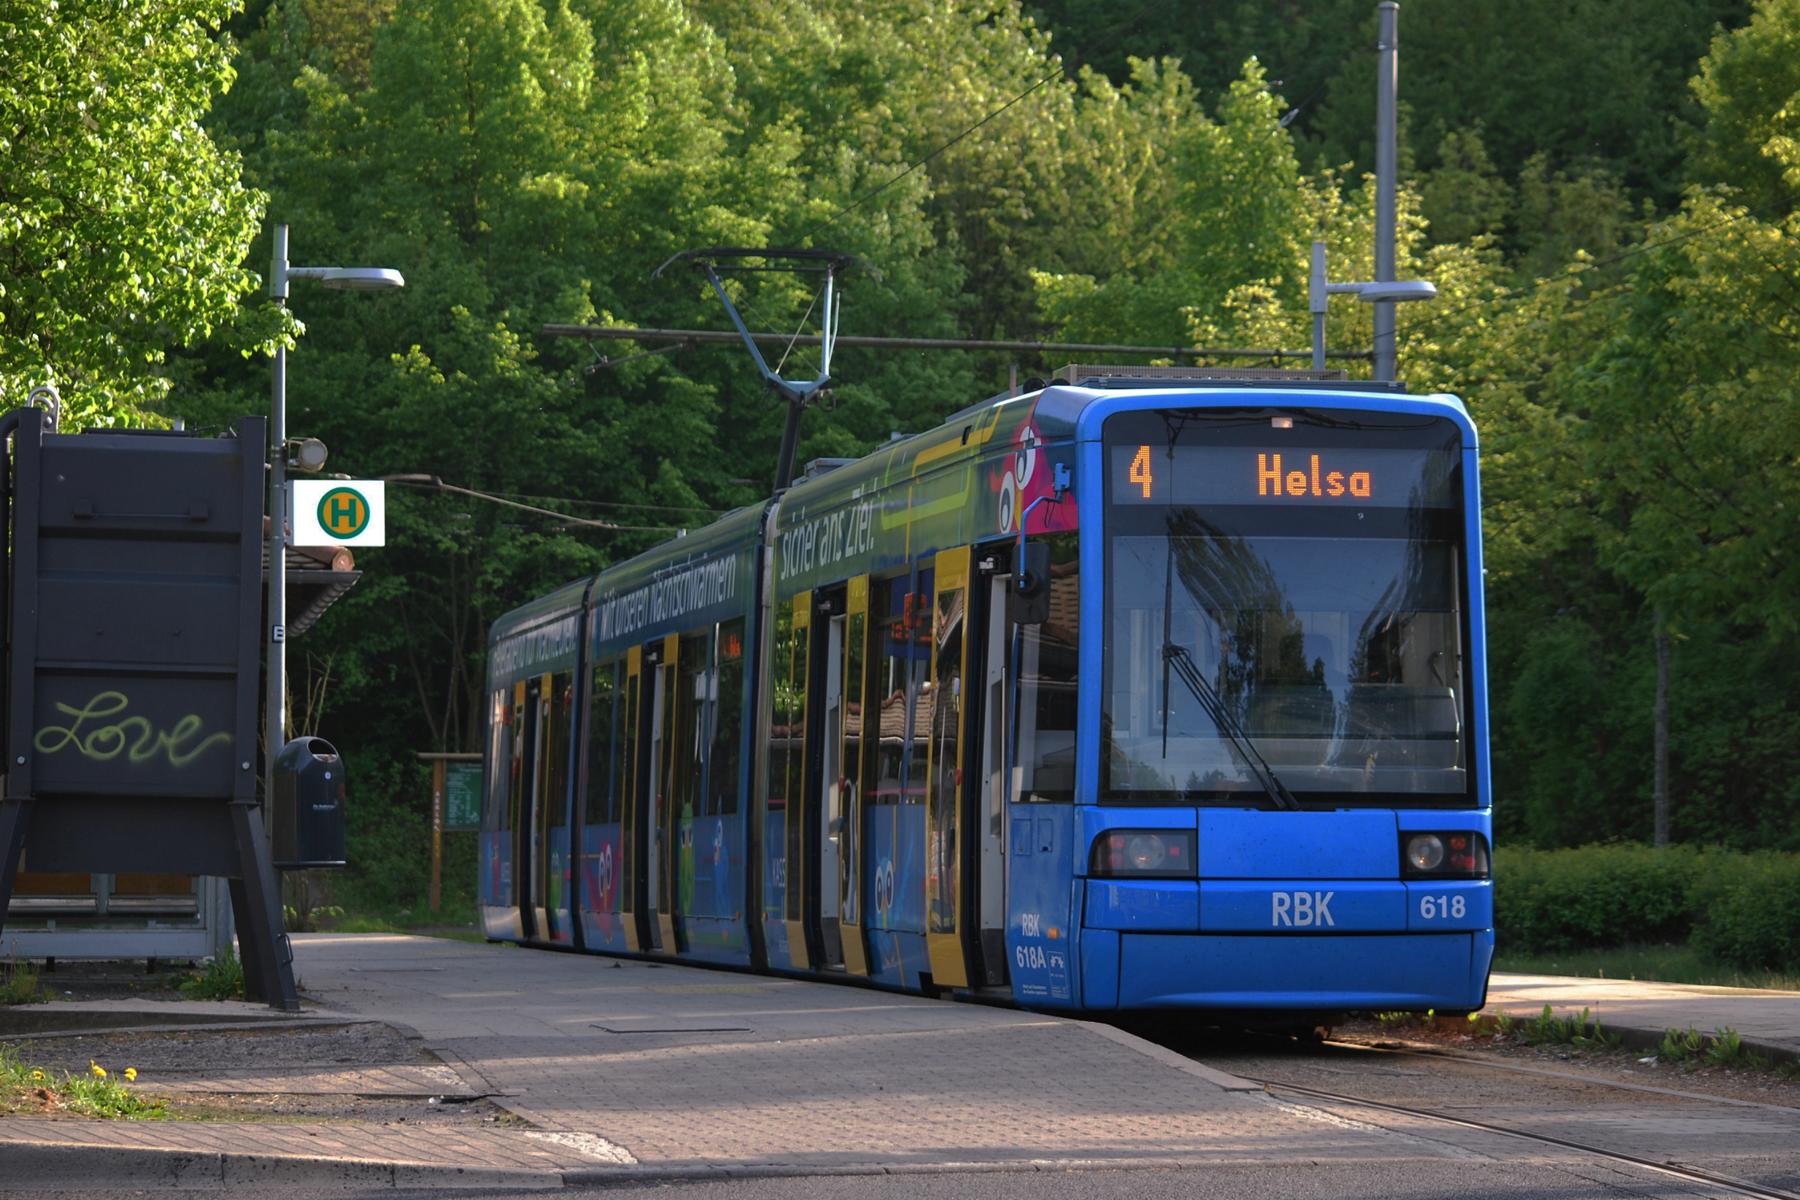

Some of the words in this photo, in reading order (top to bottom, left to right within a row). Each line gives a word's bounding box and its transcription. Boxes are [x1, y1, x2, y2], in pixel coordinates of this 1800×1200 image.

[1129, 445, 1152, 498] 4
[1257, 453, 1370, 497] Helsa
[331, 497, 358, 529] H
[820, 509, 845, 567] ans
[615, 586, 649, 637] unseren
[35, 691, 232, 768] Love
[1022, 913, 1040, 937] RBK
[1271, 891, 1335, 927] RBK
[1419, 895, 1466, 919] 618
[1016, 945, 1047, 969] 618A
